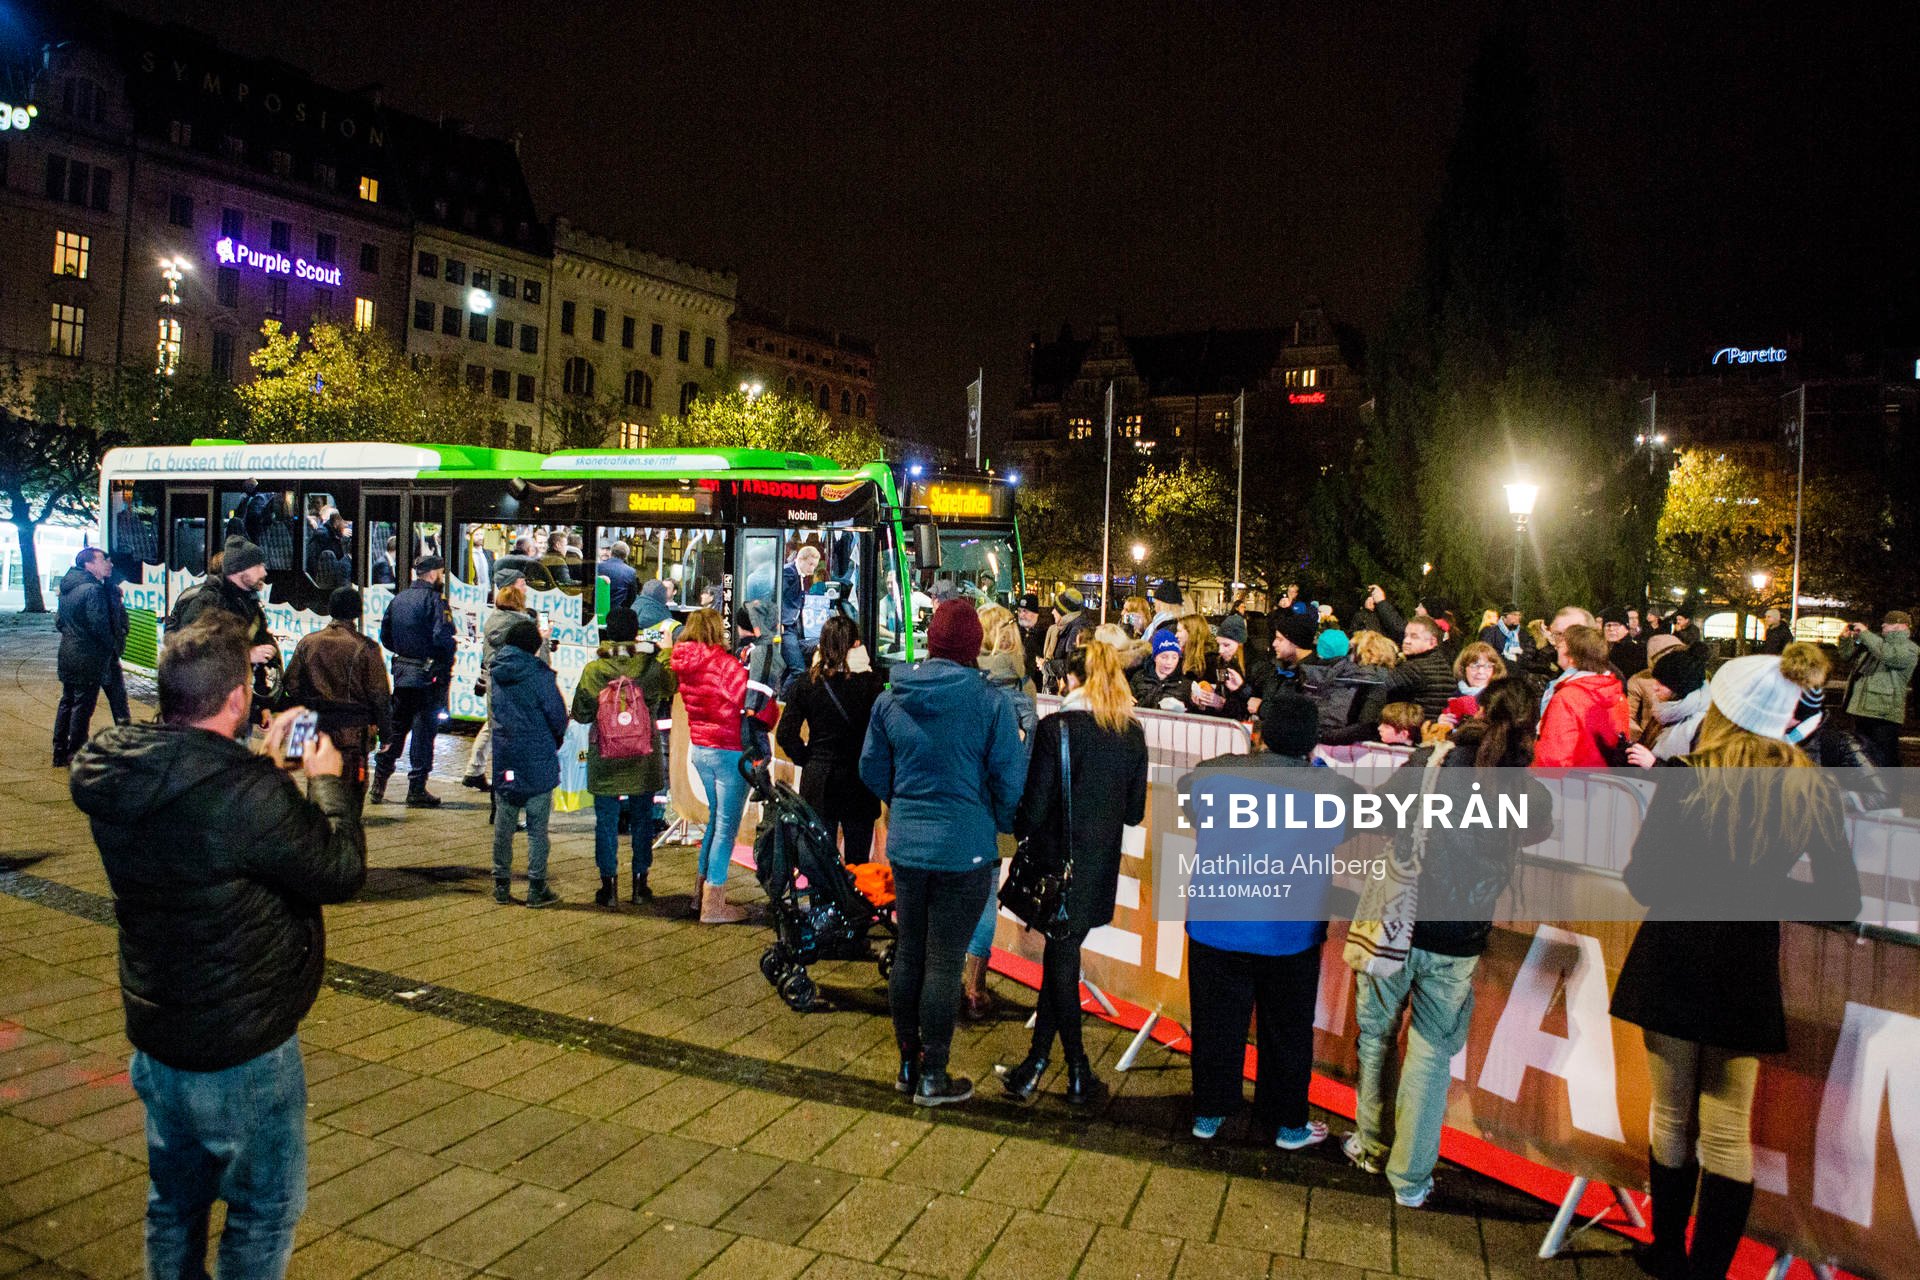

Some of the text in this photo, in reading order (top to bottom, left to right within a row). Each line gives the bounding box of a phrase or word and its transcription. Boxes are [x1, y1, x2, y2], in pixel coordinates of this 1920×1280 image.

[141, 50, 385, 148] SYMPOSION
[237, 244, 342, 285] Purple Scout
[1726, 346, 1787, 364] Pareto
[1288, 391, 1326, 404] Scandic
[145, 448, 327, 471] Ta bussen till matchen!
[788, 509, 819, 522] Nobina
